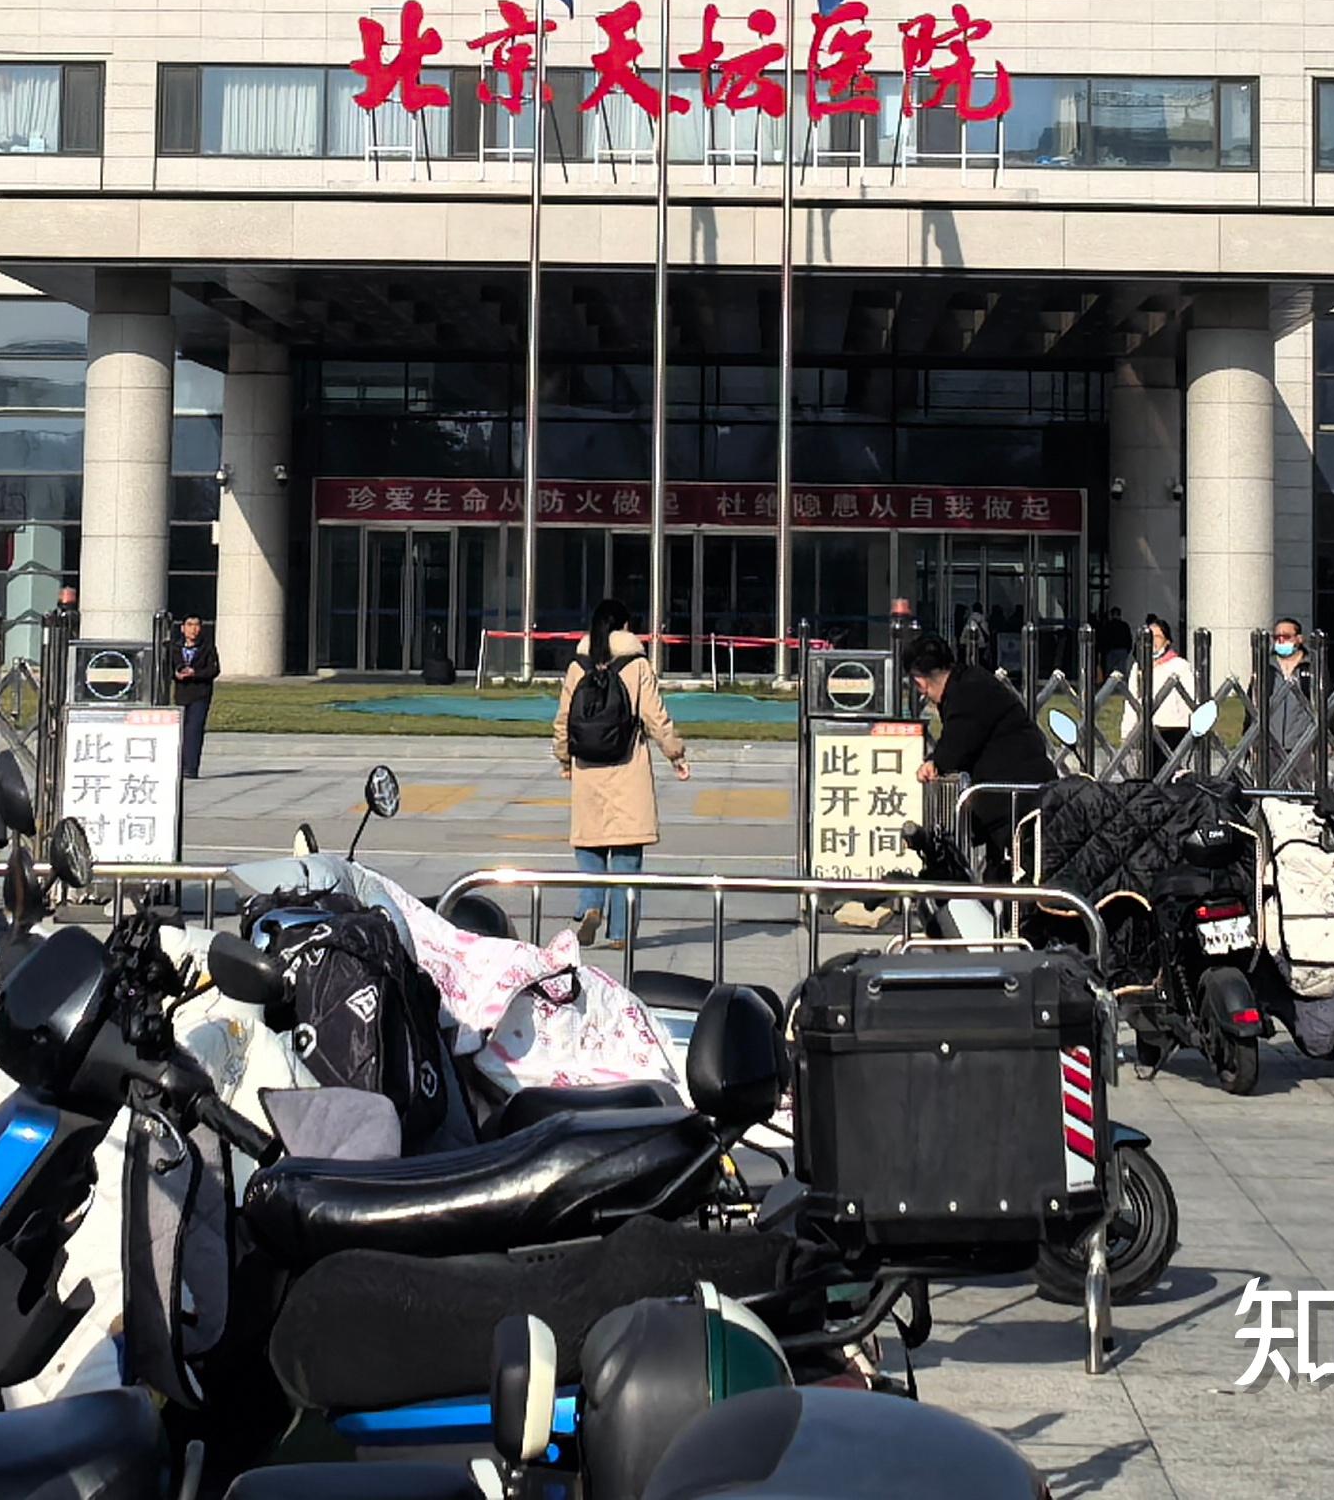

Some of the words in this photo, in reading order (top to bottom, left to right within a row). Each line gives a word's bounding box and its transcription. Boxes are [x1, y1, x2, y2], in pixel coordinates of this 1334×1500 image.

[349, 0, 1014, 123] 北京天坛医院
[73, 733, 158, 763] 此口
[820, 744, 904, 776] 此口
[71, 774, 160, 805] 开放
[820, 784, 908, 817] 开放
[820, 826, 907, 858] 时间
